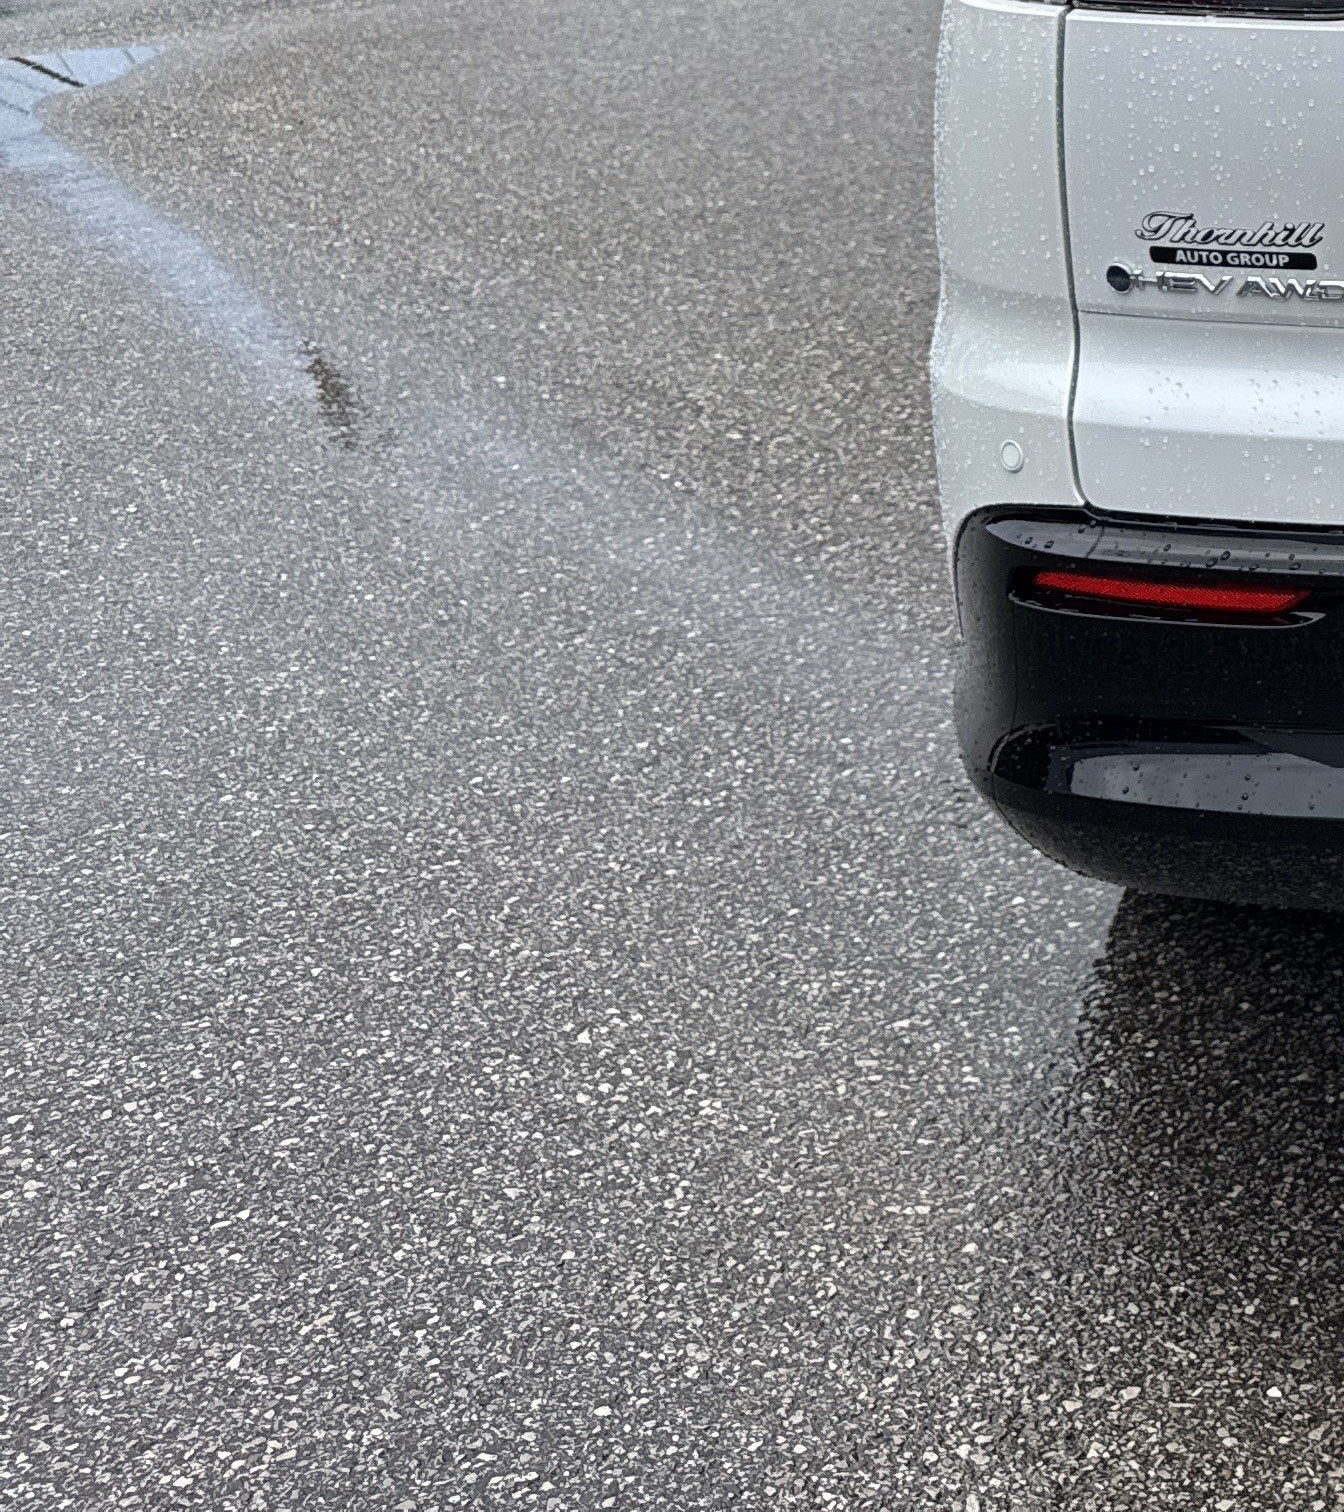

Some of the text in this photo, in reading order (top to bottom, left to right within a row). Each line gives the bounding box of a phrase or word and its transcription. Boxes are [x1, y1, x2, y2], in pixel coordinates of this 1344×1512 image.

[1134, 210, 1326, 249] Thornhill
[1175, 249, 1290, 267] AUTO GROUP
